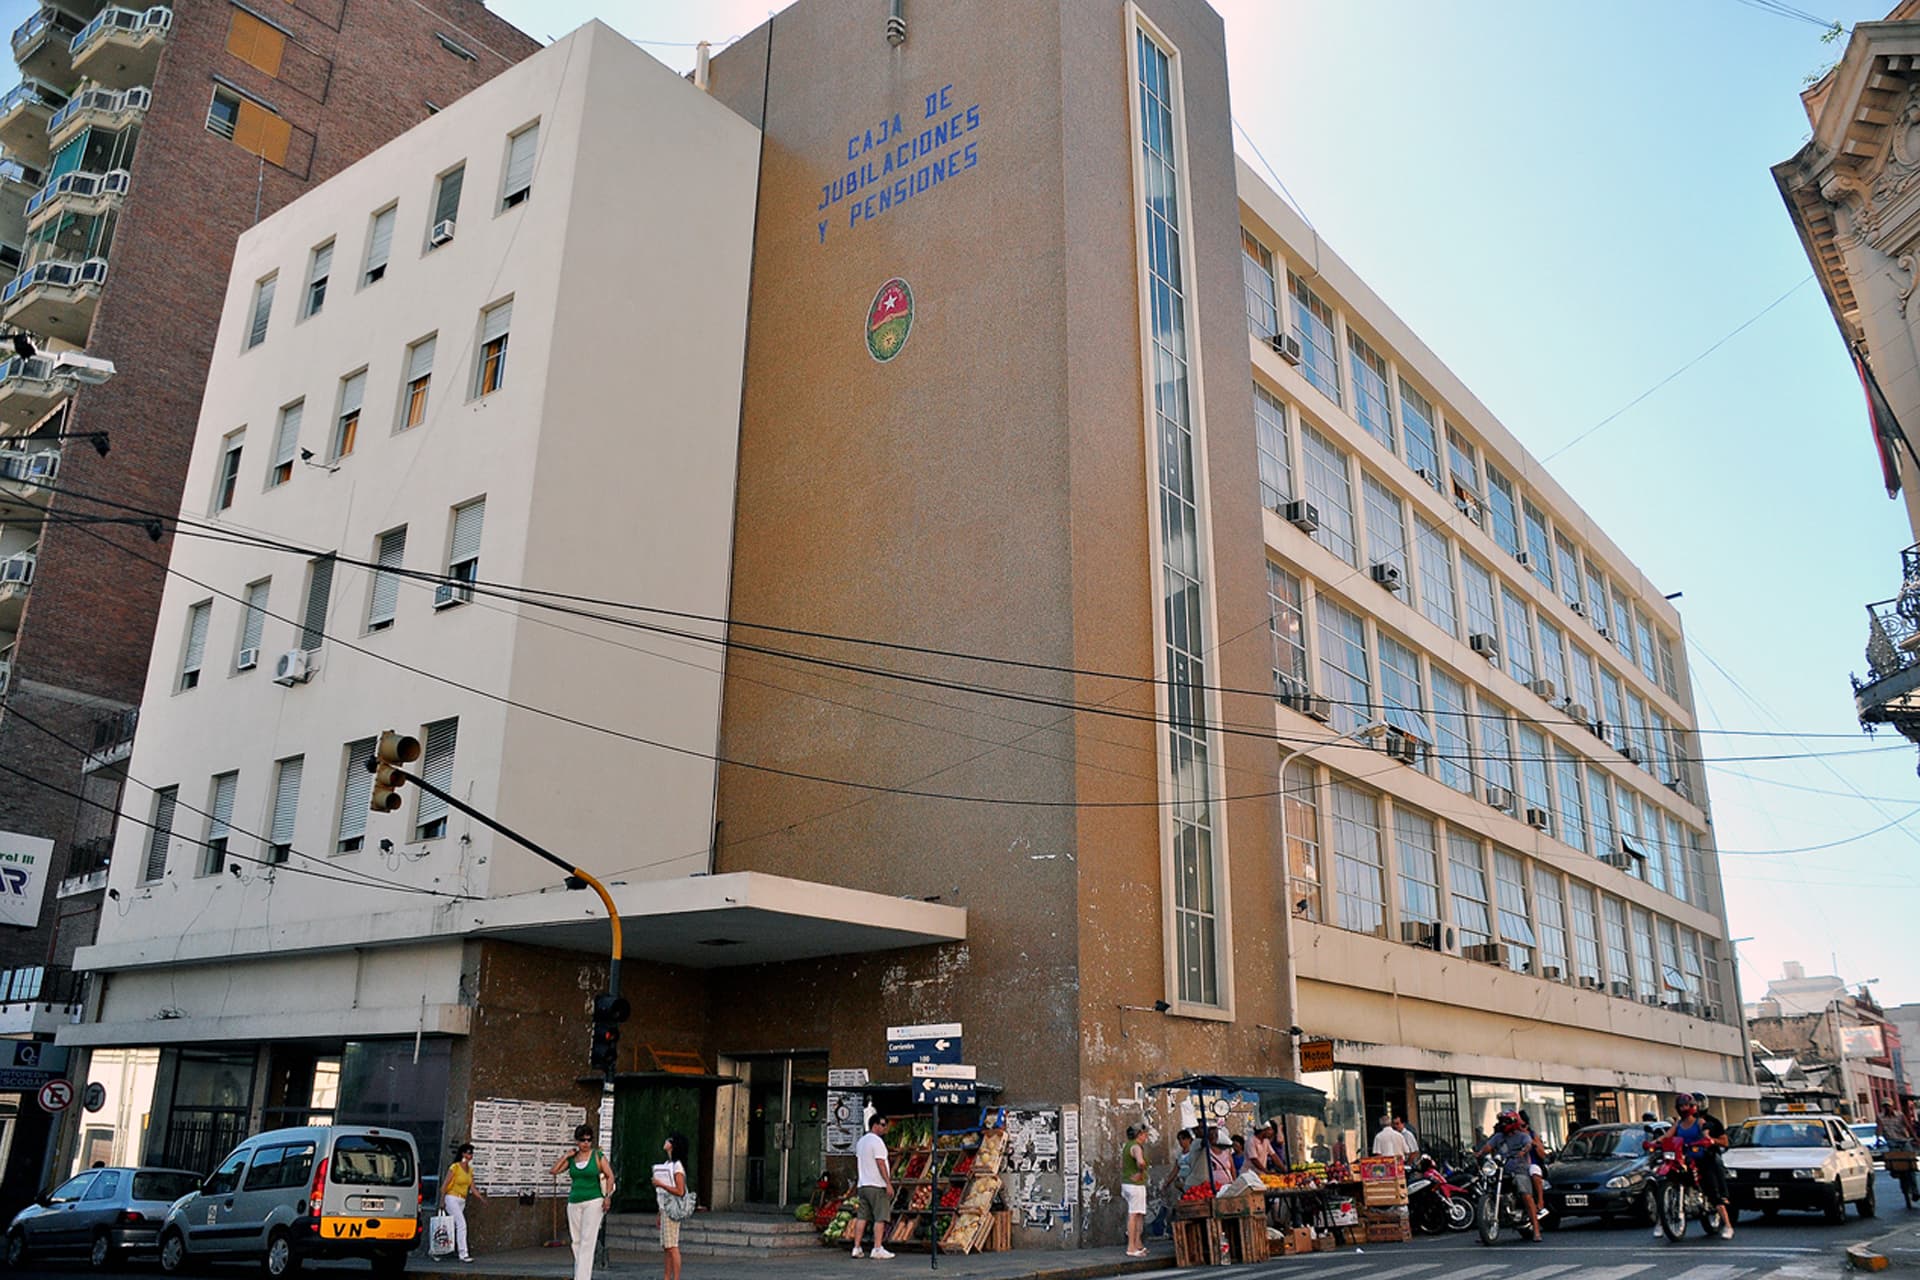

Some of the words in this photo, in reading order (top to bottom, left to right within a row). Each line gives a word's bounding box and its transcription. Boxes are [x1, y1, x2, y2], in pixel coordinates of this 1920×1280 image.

[818, 104, 980, 211] JUBILACIONES
[848, 112, 902, 161] CAJA
[925, 84, 952, 119] DE
[818, 219, 828, 244] Y
[850, 141, 977, 228] PENSIONES
